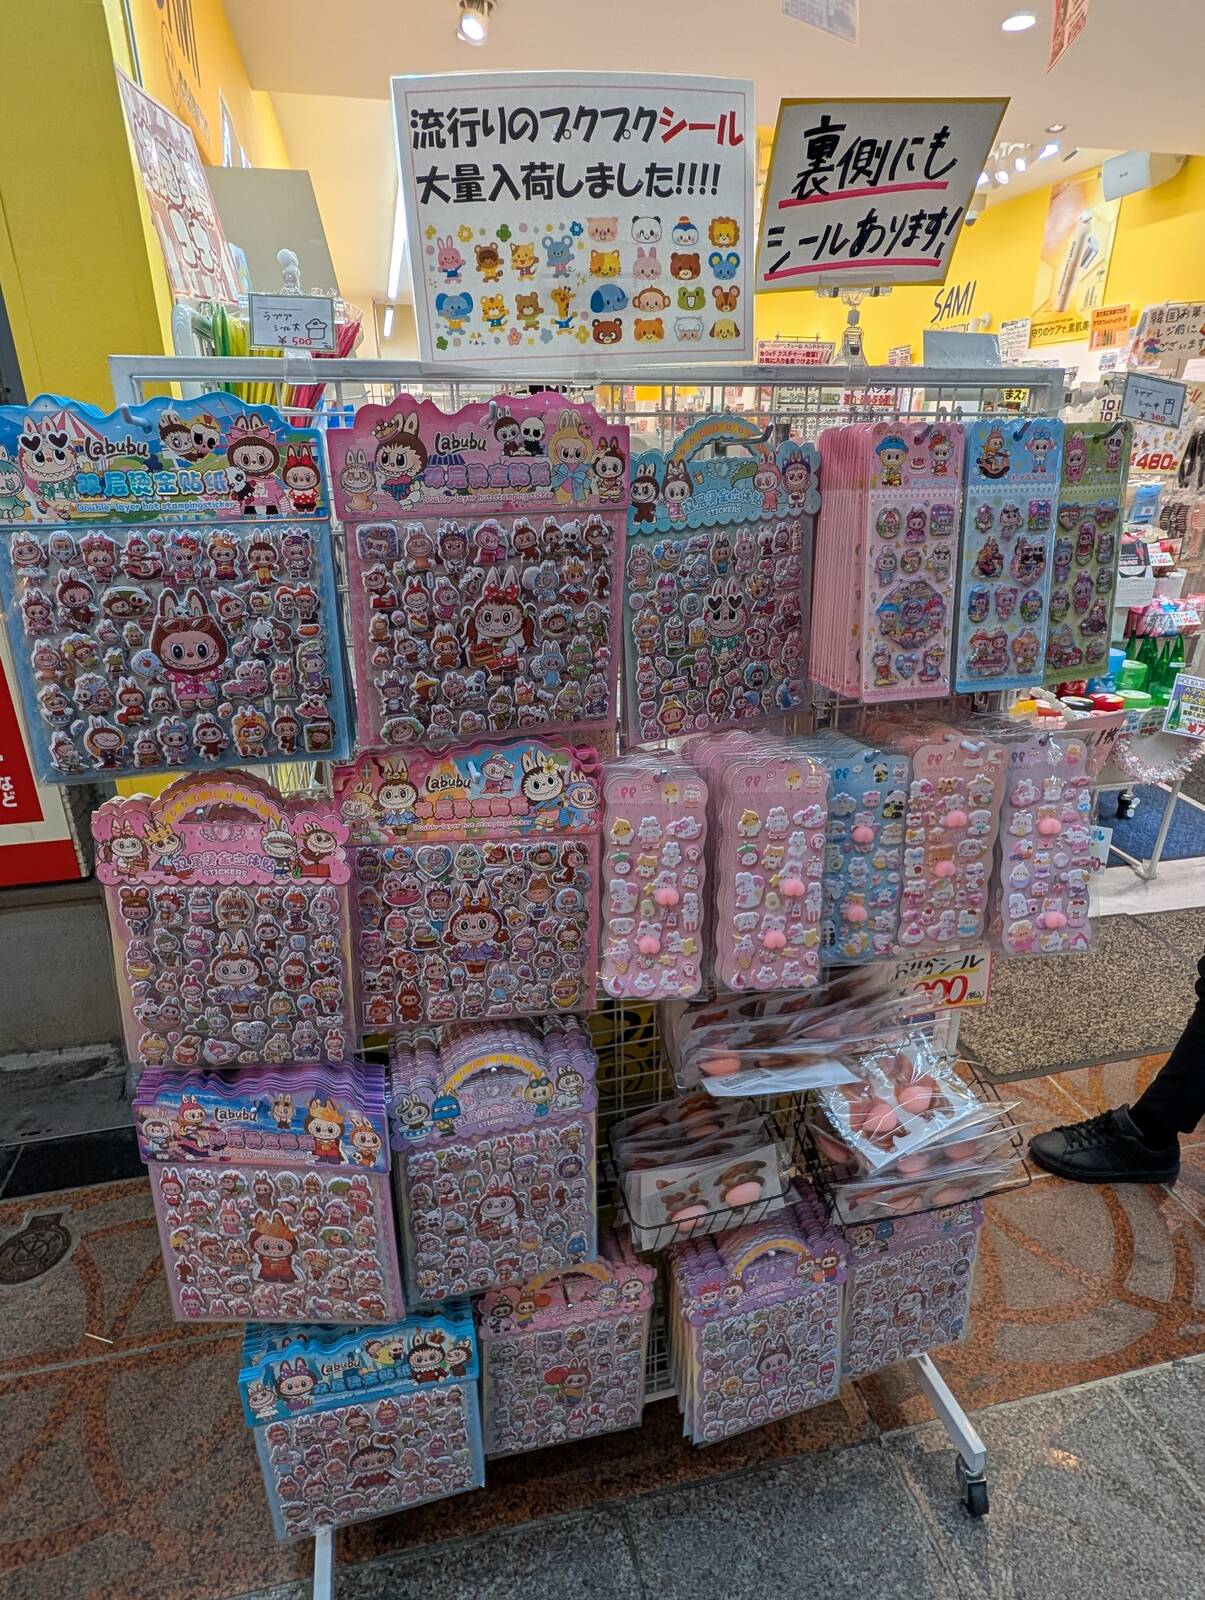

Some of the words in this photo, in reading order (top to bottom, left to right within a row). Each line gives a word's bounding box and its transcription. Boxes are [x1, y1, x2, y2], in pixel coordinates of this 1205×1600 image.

[410, 105, 744, 149] 流行りのプクプクシール
[791, 115, 958, 200] 裏側にも
[416, 161, 721, 205] 大量入荷しました!!!!
[768, 206, 964, 273] シールあります!
[931, 280, 977, 323] SAMI
[84, 435, 149, 462] Labubu
[435, 432, 487, 455] Labubu
[705, 505, 743, 517] STICKERS
[425, 775, 472, 794] Labubu
[203, 868, 248, 878] STICKERS
[214, 1107, 258, 1123] Labubu
[320, 1358, 361, 1378] Labubu
